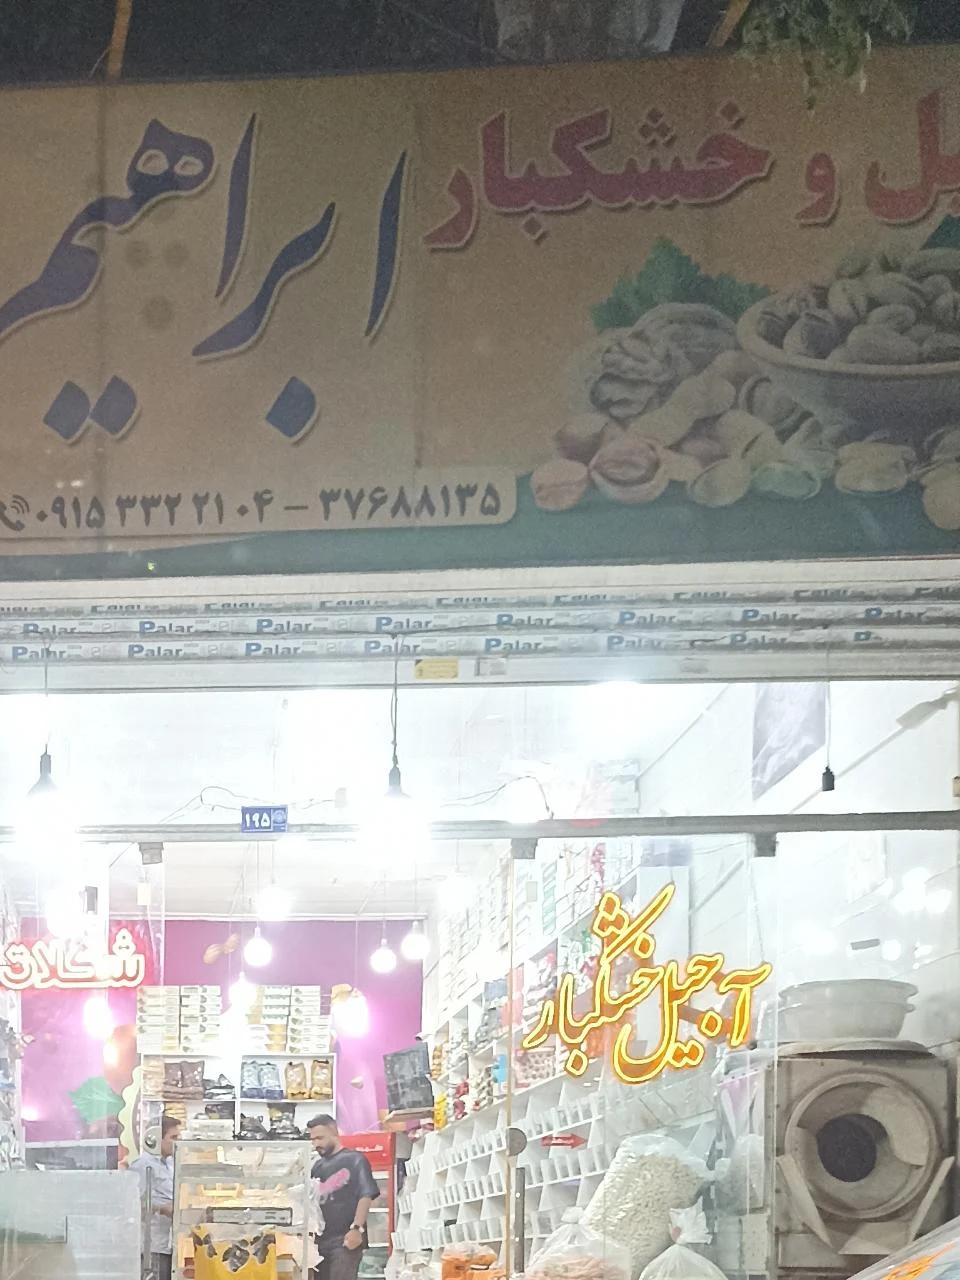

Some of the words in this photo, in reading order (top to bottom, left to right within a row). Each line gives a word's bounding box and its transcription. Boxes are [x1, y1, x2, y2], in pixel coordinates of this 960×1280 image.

[423, 100, 775, 250] خشکبار
[795, 151, 838, 224] و
[319, 482, 502, 522] ۳۷۶۸۸۱۳۵
[128, 644, 182, 658] Palar
[245, 642, 301, 657] Palar
[484, 638, 541, 652] Palar
[139, 620, 193, 634] Palar
[256, 618, 312, 633] Palar
[375, 616, 432, 631] Palar
[245, 812, 270, 828] ۱۹۵
[522, 880, 677, 1076] خشکبار
[613, 952, 774, 1083] آجیل
